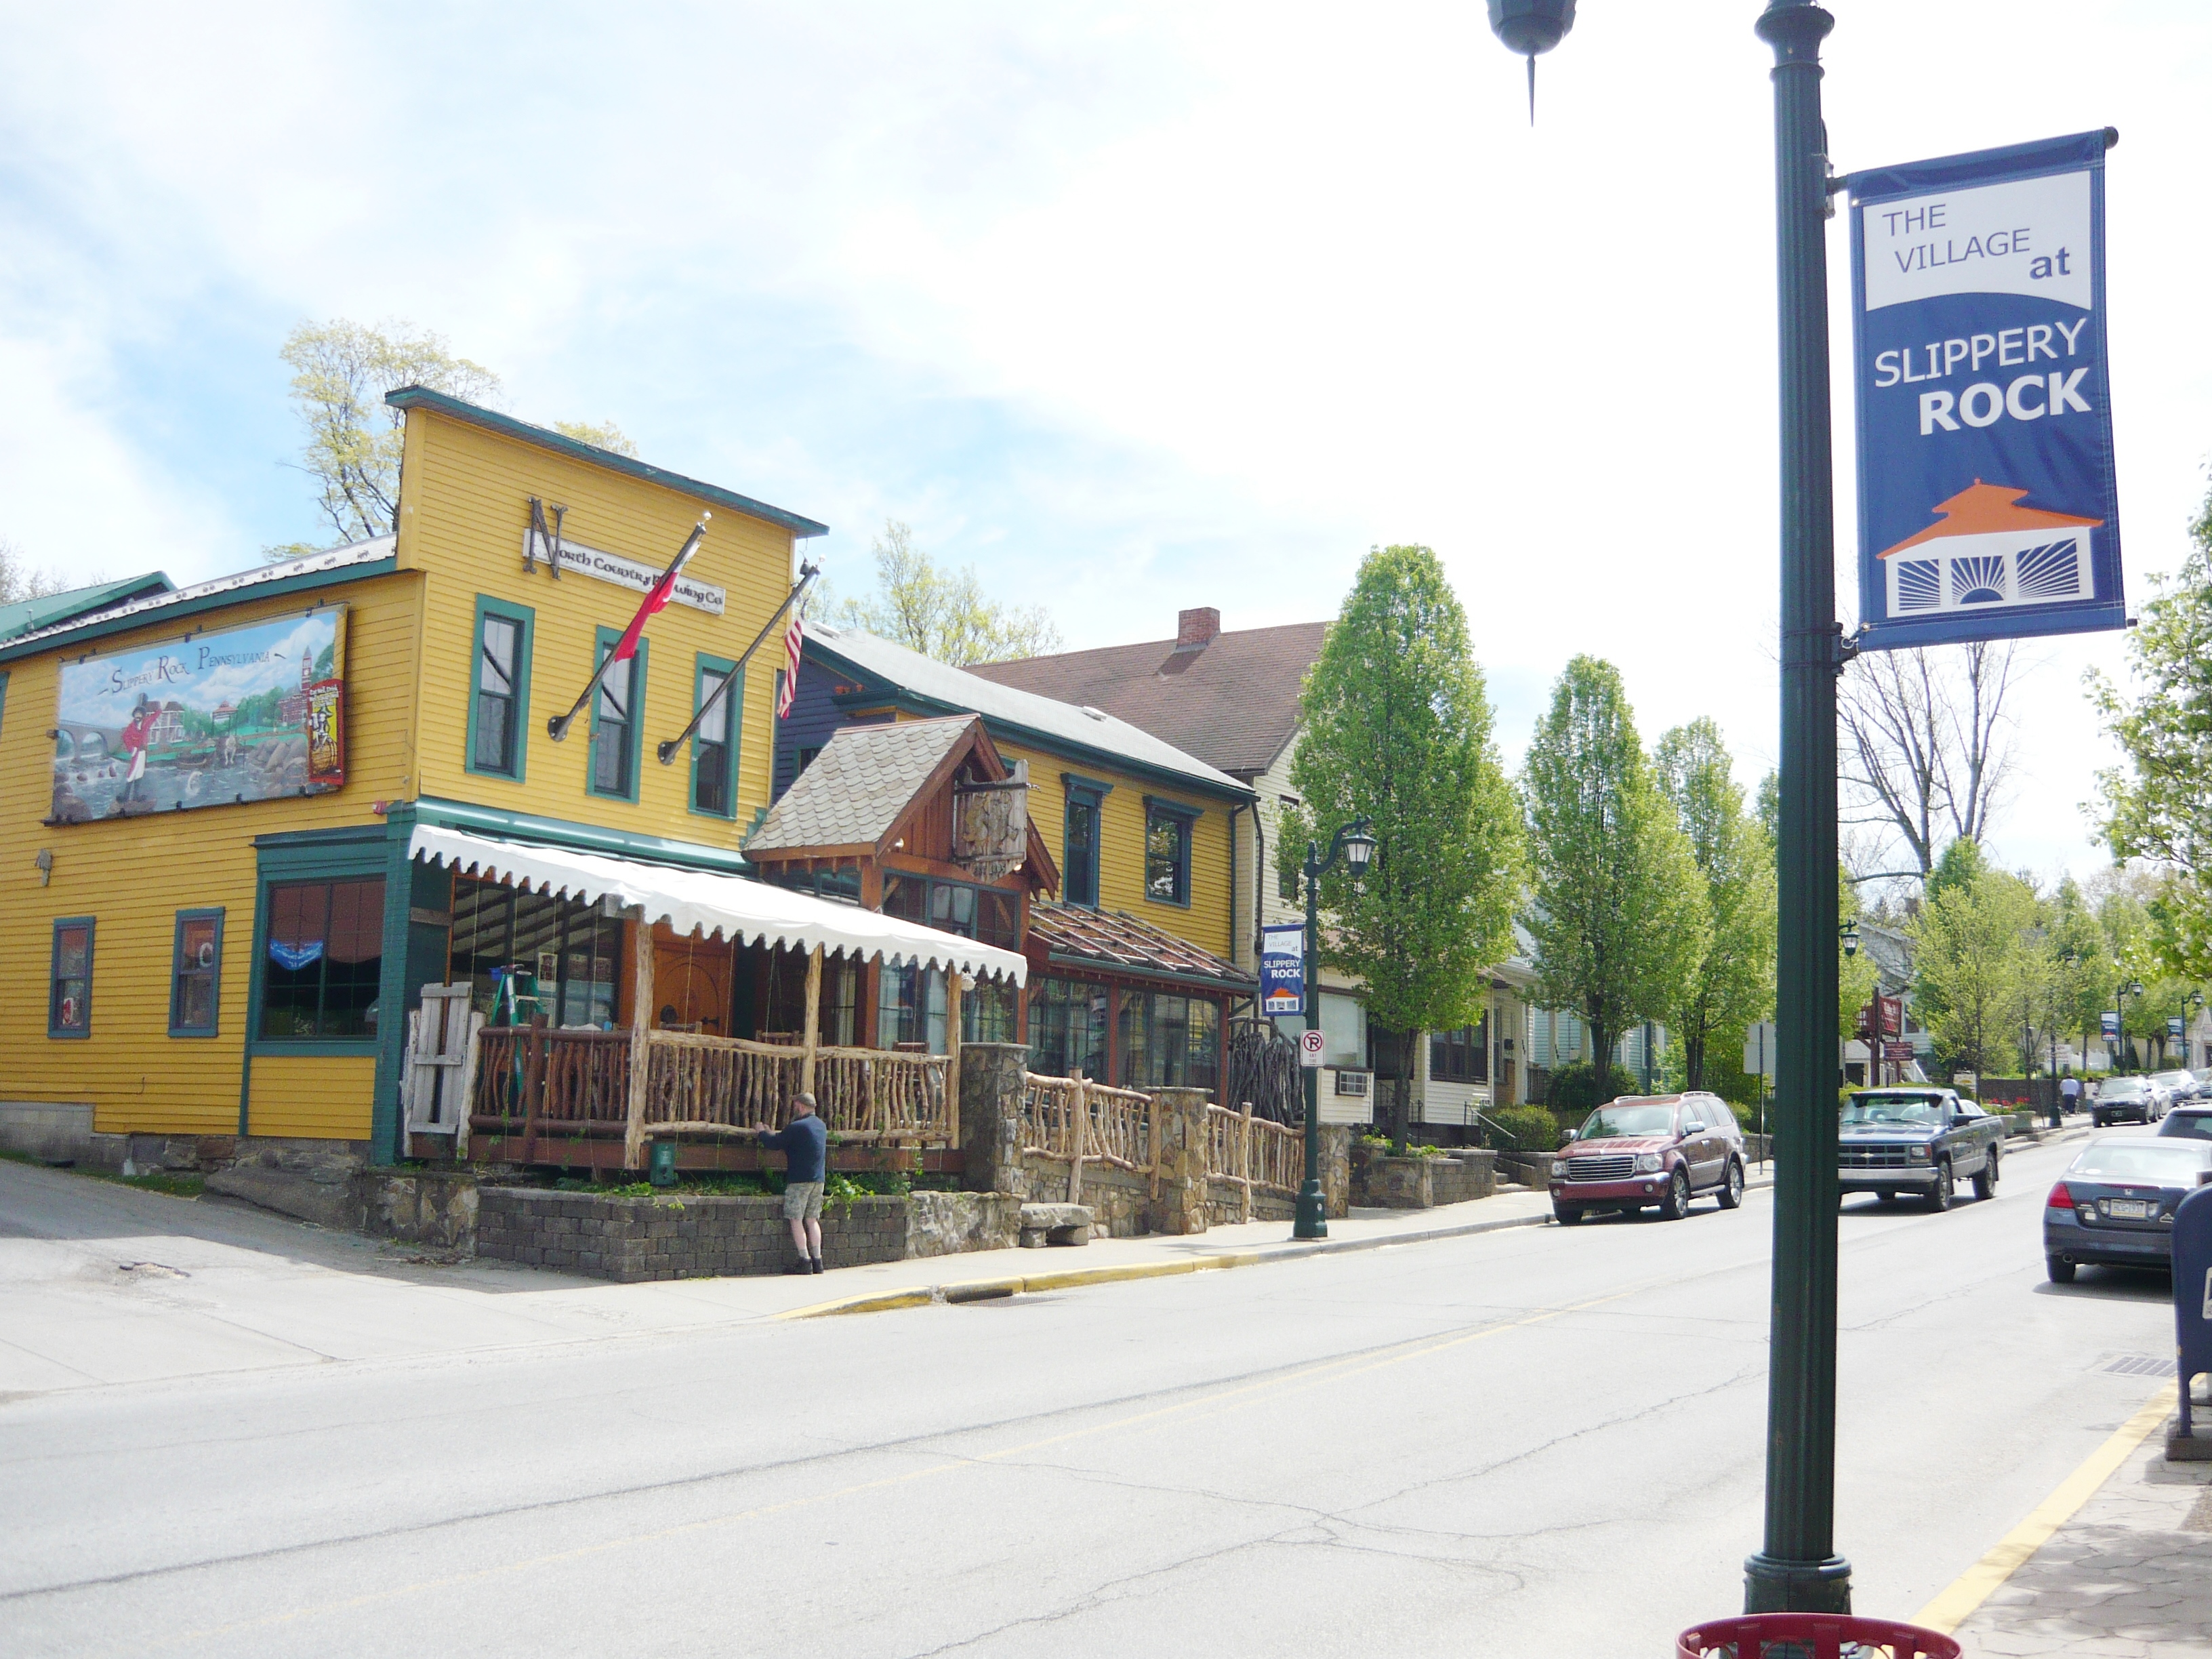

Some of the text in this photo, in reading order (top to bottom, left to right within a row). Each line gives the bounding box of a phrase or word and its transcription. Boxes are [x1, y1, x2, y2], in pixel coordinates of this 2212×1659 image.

[1882, 203, 1946, 237] THE
[1894, 228, 2030, 273] VILLAGE
[2029, 246, 2071, 280] at
[1875, 317, 2087, 388] SLIPPERY
[1919, 367, 2092, 436] ROCK
[523, 496, 592, 581] North
[594, 558, 651, 587] Country
[652, 573, 705, 603] Bwing
[1264, 960, 1300, 968] SLIPPERY
[1271, 969, 1300, 979] ROCK
